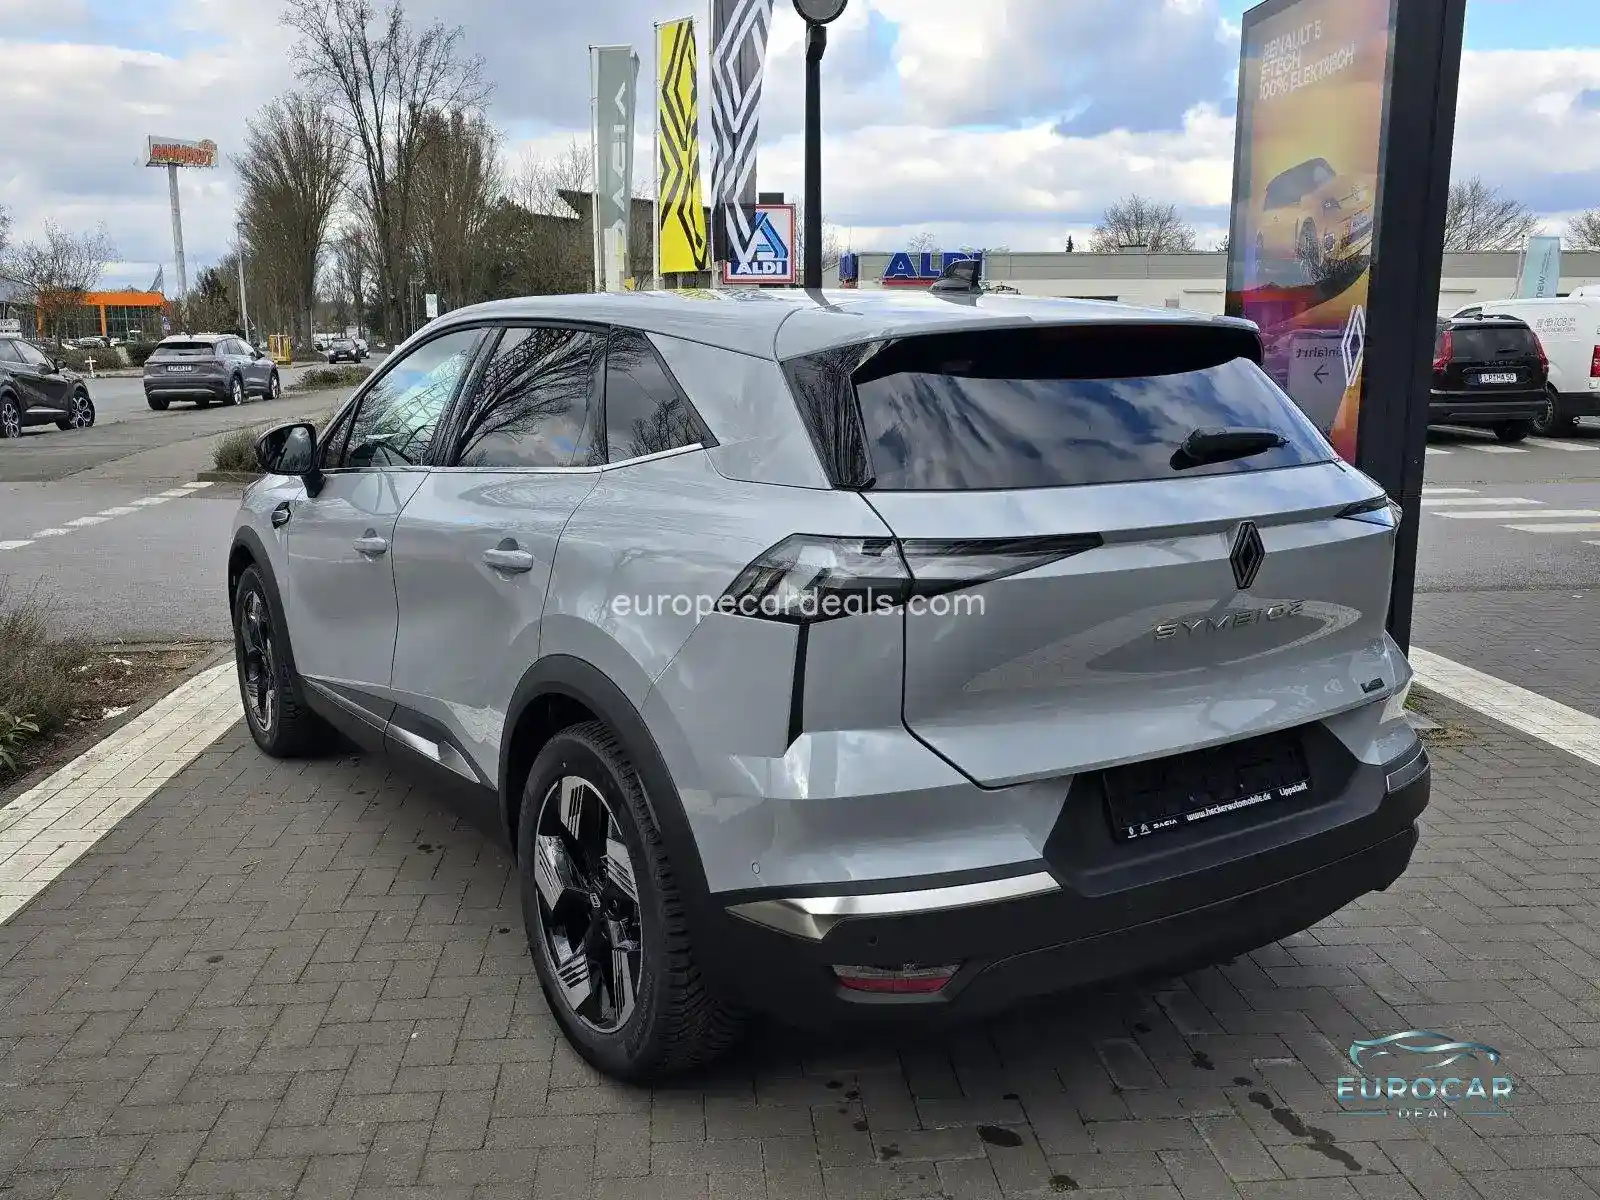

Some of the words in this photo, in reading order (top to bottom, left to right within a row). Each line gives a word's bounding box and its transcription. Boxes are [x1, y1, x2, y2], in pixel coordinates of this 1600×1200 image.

[1263, 23, 1314, 58] RENAULT
[1260, 75, 1289, 100] 100%
[736, 261, 783, 275] ALDI
[1153, 600, 1306, 640] SYMBIOZ
[1186, 793, 1271, 822] www.heckerautomobile.de
[1279, 781, 1308, 796] Lippstadt
